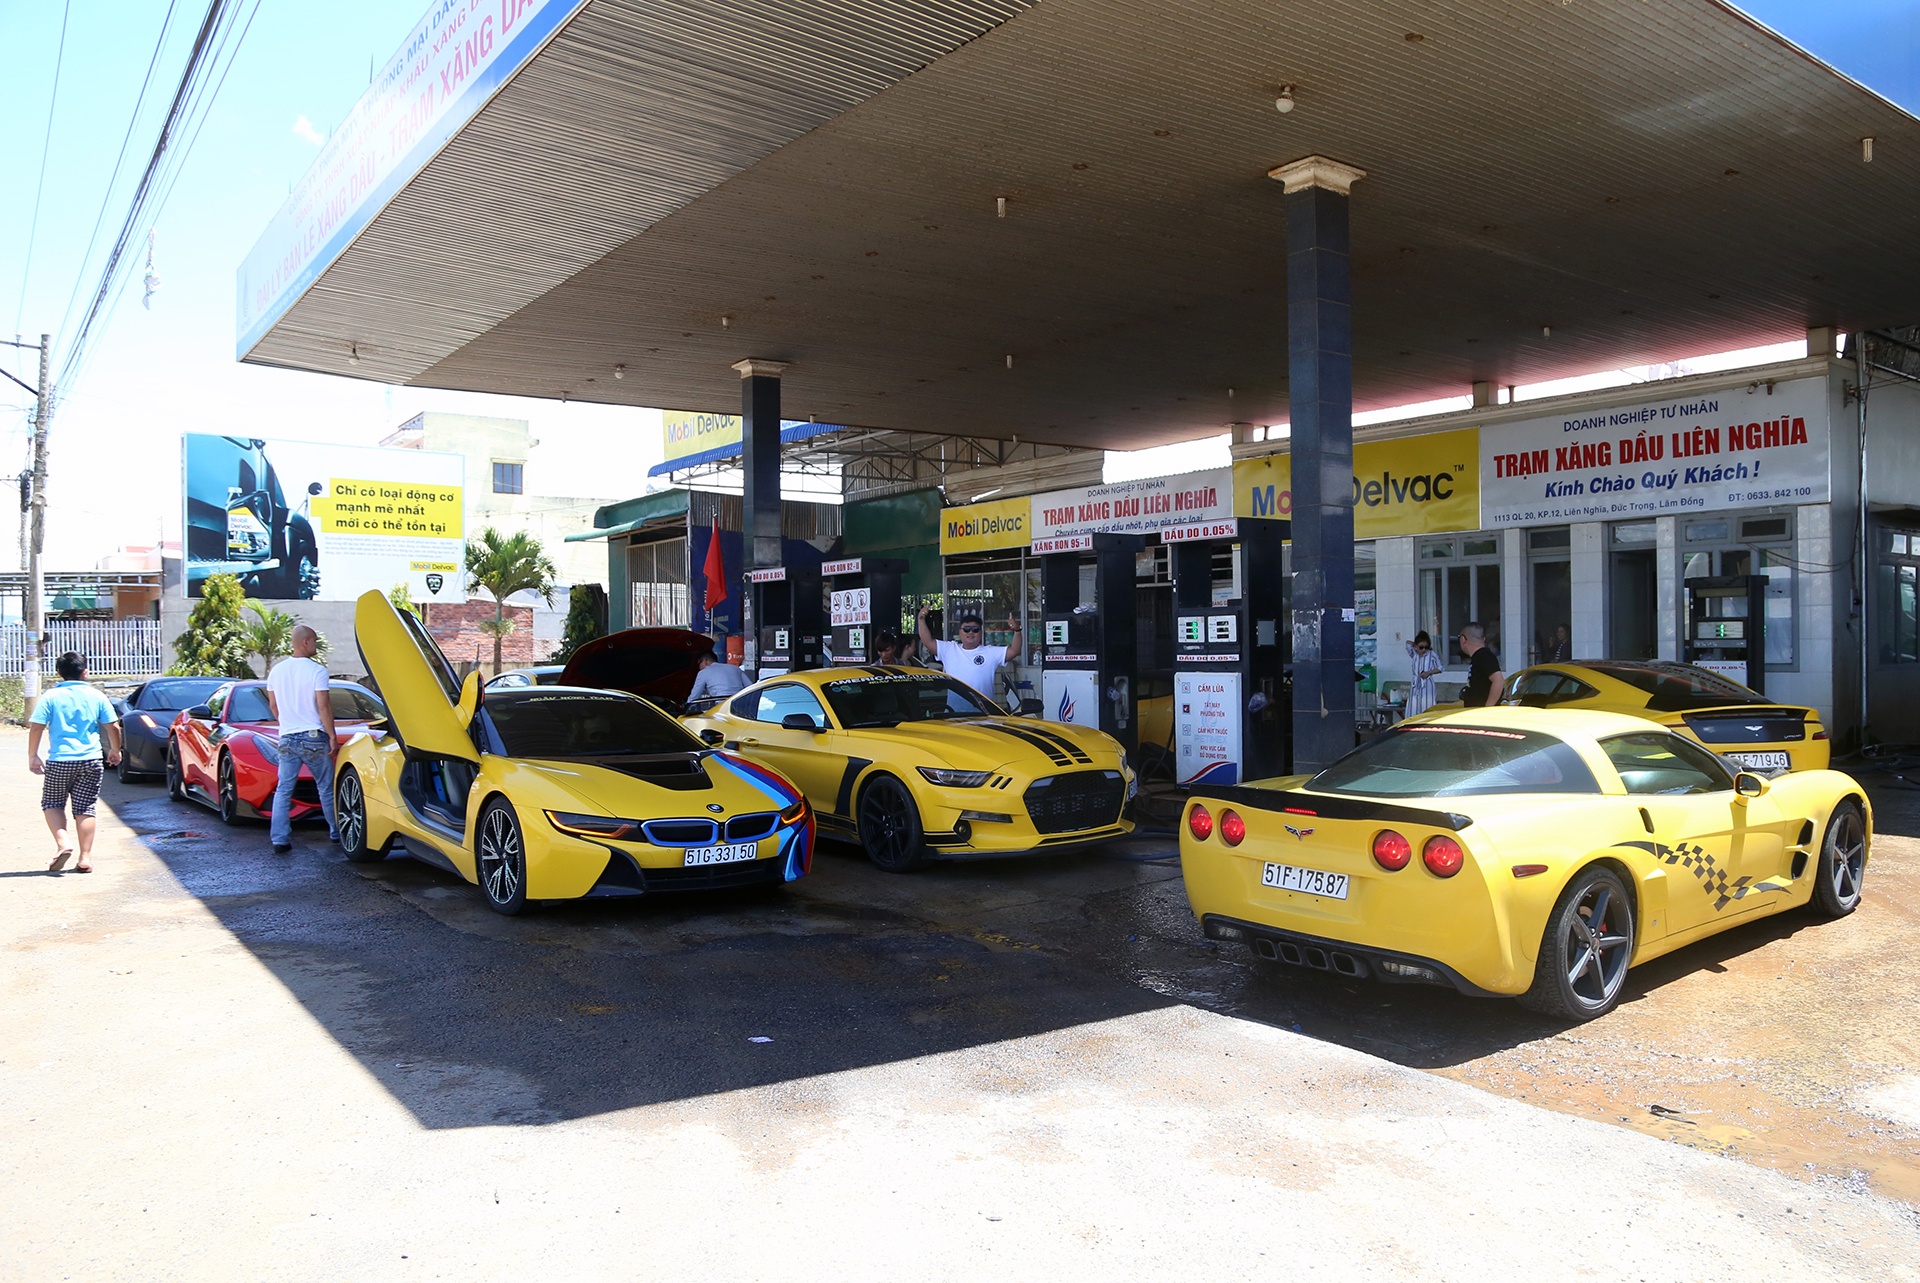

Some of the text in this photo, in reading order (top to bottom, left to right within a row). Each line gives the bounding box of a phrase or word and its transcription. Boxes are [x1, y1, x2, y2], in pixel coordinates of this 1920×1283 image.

[406, 25, 429, 63] MẠI
[350, 149, 375, 205] DẦU
[389, 82, 434, 158] TRẠM
[440, 14, 494, 105] XĂNG
[1563, 400, 1719, 432] DOANH NGHIỆP TƯ NHÂN
[668, 414, 735, 444] Mobil Delvac
[1493, 414, 1808, 480] TRẠM XĂNG DẦU LIÊN NGHĨA
[1087, 479, 1166, 498] DOANH NGHIỆP TƯ NHÂN
[1545, 480, 1584, 498] Kính
[1589, 474, 1635, 494] Chào
[1641, 468, 1678, 490] Quý
[1684, 462, 1748, 484] Khách
[336, 484, 454, 503] Chỉ có loại động cơ
[1728, 487, 1811, 502] ĐT: 0633. 842 100
[336, 502, 425, 515] mạnh mẽ nhất
[1043, 485, 1218, 528] TRẠM XĂNG DẦU LIÊN NGHĨA
[1494, 496, 1705, 522] 1113 QL 20, KP.12, Liên Nghĩa, Đức Trọng, Lâm Đồng
[336, 517, 446, 535] mới có thể tồn tại
[948, 515, 1023, 539] Mobil Delvac
[1111, 518, 1125, 531] dầu
[1144, 518, 1159, 530] phụ
[1164, 524, 1234, 541] DẦU DO 0.05%
[1034, 537, 1090, 552] XĂNG RON 95-II
[413, 562, 454, 571] Mobil Delvac
[1198, 683, 1225, 693] CẤM LỬA
[1730, 754, 1786, 766] F-719.46
[686, 844, 755, 864] 51G-331.50
[1265, 863, 1346, 895] 51F-175.87
